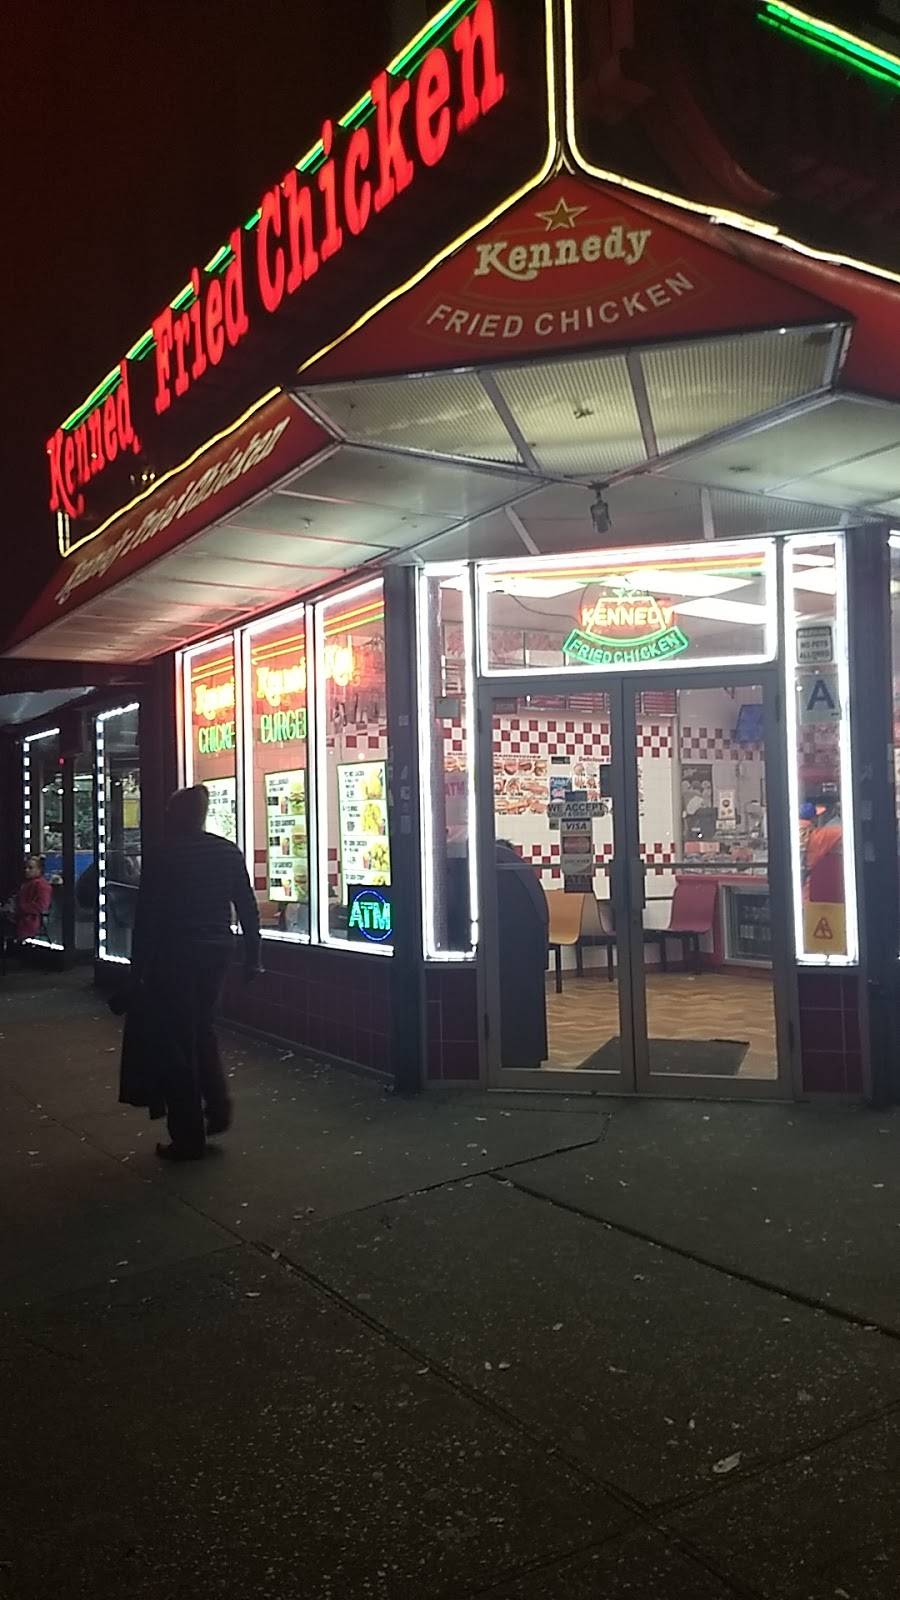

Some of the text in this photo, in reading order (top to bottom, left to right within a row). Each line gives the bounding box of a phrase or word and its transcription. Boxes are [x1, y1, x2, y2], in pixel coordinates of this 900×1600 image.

[152, 226, 249, 416] Fried
[256, 0, 505, 313] Chicken
[474, 225, 651, 281] Kennedy
[427, 272, 694, 338] FRIED CHICKEN
[581, 606, 675, 627] KENNEDY
[569, 632, 681, 664] FRIED CHICKEN
[806, 680, 835, 711] A
[565, 802, 605, 812] ACCEPT
[348, 900, 392, 931] ATM
